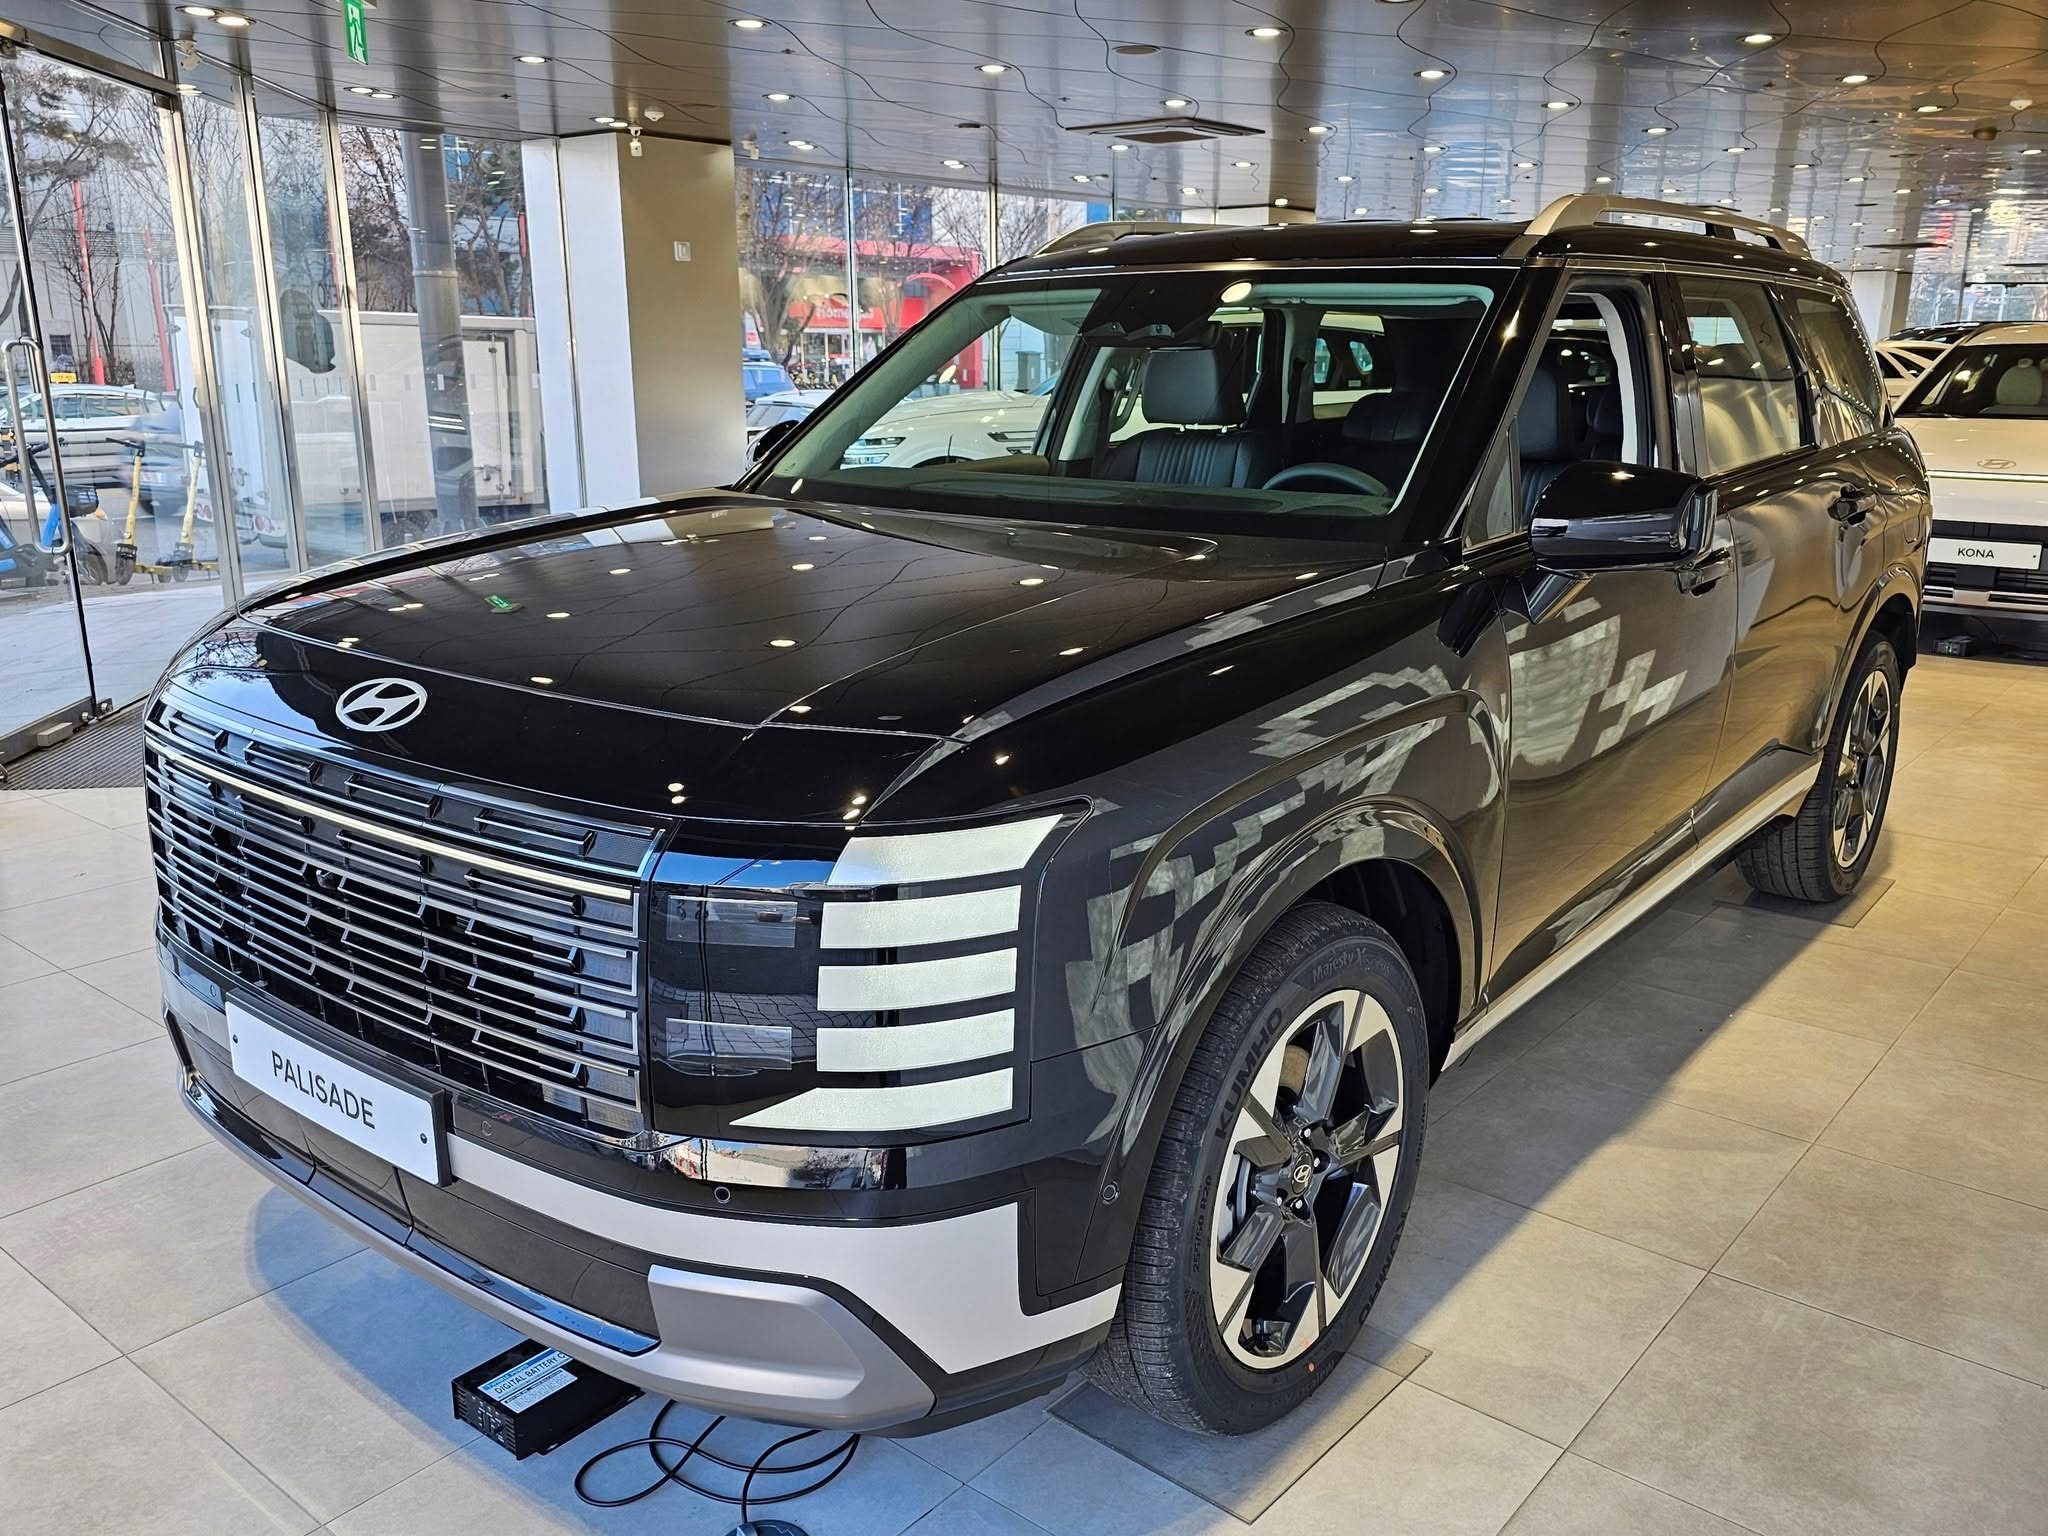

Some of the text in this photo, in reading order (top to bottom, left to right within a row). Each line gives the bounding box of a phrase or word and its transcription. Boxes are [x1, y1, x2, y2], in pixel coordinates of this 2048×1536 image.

[1957, 547, 1995, 559] KONA
[271, 1050, 376, 1129] PALISADE
[1214, 1007, 1283, 1140] KUMHO
[1192, 1175, 1213, 1273] 255/50 R20
[494, 1375, 527, 1395] DIGITAL
[524, 1357, 558, 1378] BATTERY
